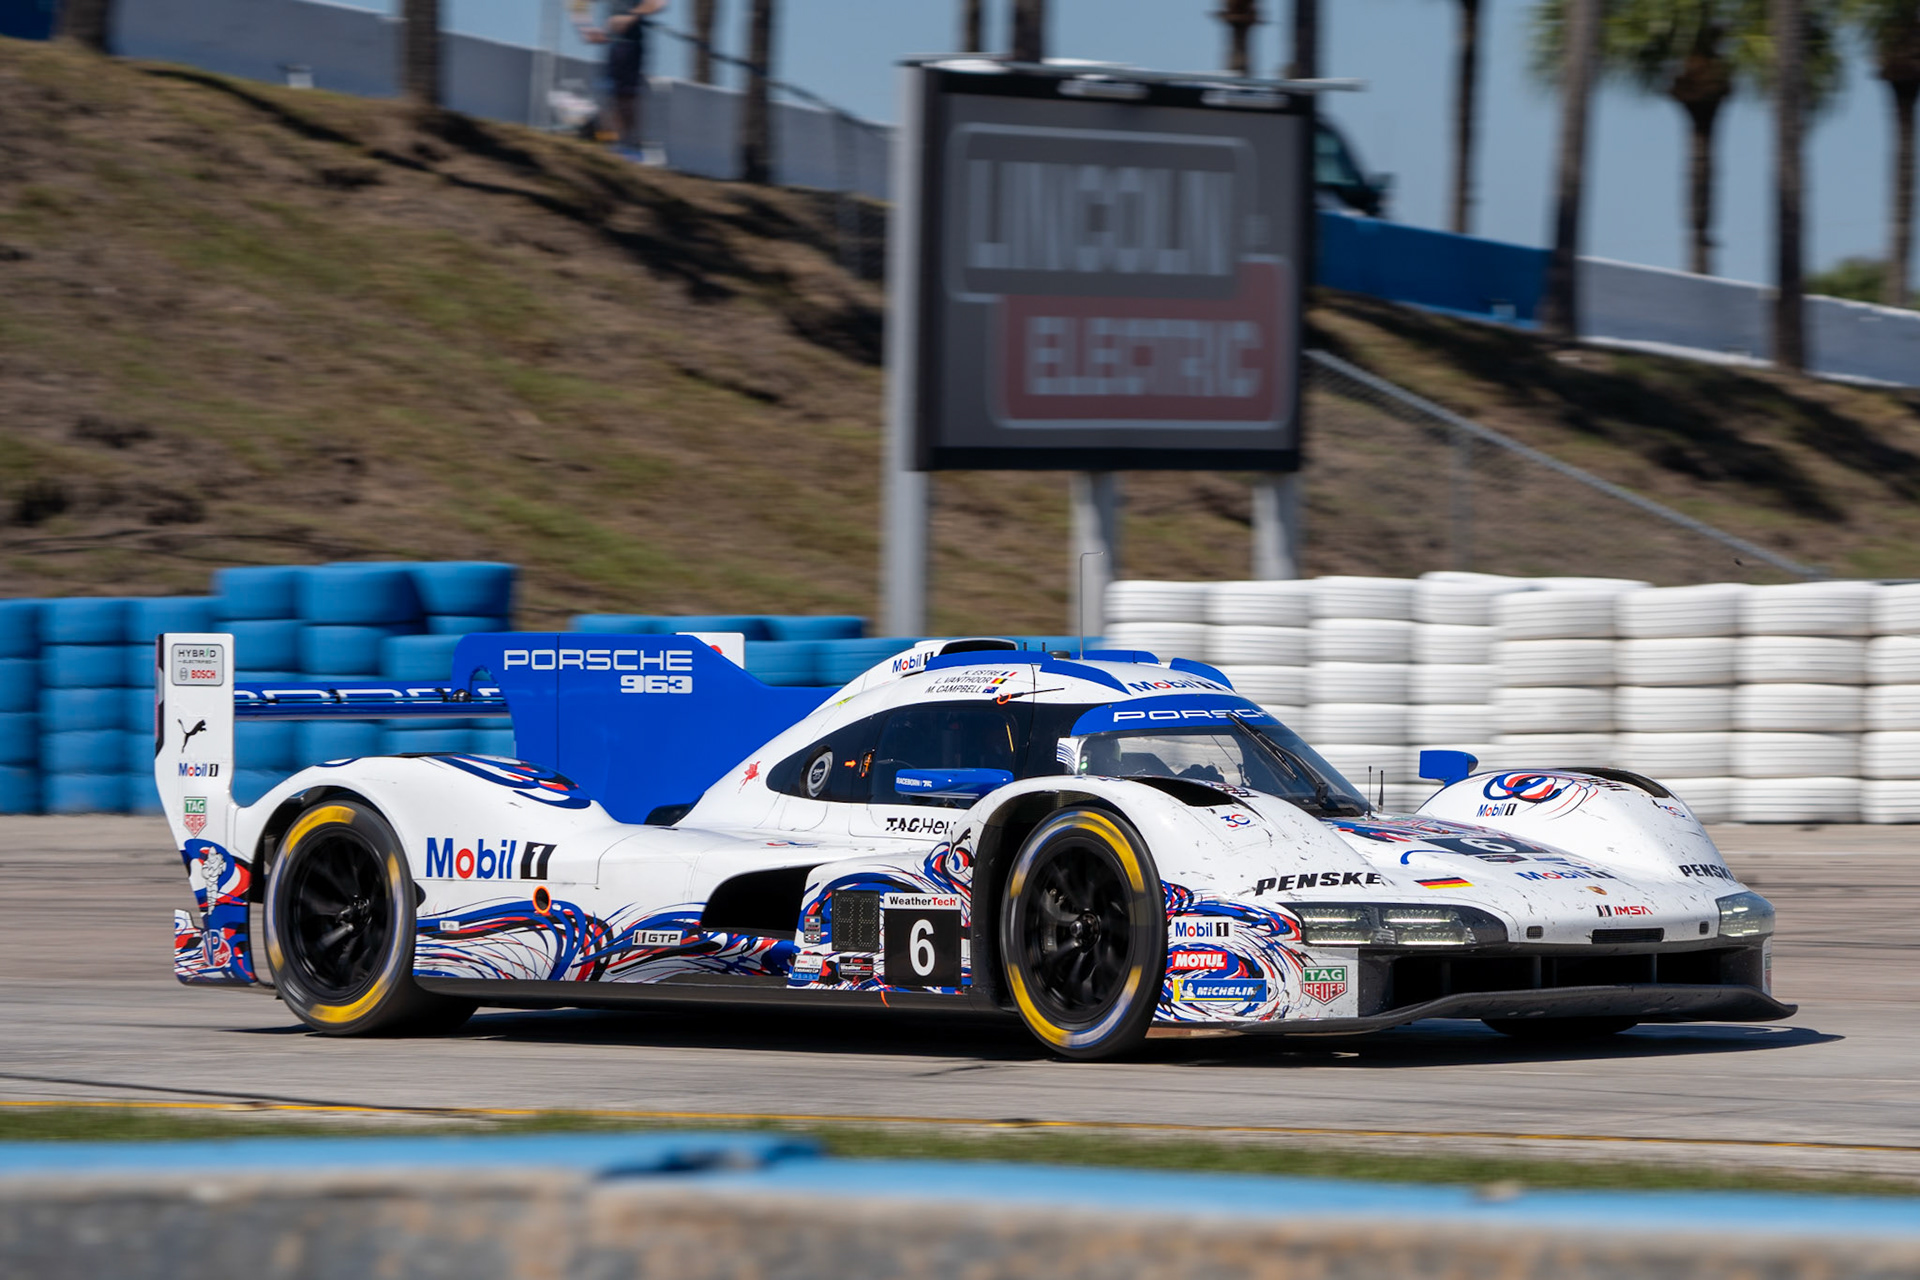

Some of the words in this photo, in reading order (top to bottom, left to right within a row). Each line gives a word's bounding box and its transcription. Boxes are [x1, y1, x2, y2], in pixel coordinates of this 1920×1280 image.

[968, 159, 1234, 275] LINCOLN
[1023, 316, 1263, 397] ELECTRIC
[178, 648, 216, 657] HYBRID
[504, 650, 693, 671] PORSCHE
[892, 653, 922, 673] Mobil
[191, 669, 216, 679] BOSCH
[620, 675, 693, 694] 963
[936, 684, 982, 693] CAMPBELL
[1127, 679, 1198, 692] Mobil
[1113, 708, 1268, 723] PORSCH
[178, 763, 208, 777] Mobil
[208, 763, 219, 777] 1
[186, 800, 205, 812] TAG
[1476, 803, 1507, 817] Mobil
[1504, 803, 1518, 816] 1
[1460, 838, 1517, 853] 6
[425, 837, 517, 879] Mobil
[520, 841, 557, 880] 1
[1514, 869, 1592, 881] Mobil
[1678, 864, 1737, 882] PENSK
[1255, 872, 1382, 896] PENSKE
[889, 896, 957, 906] WeatherTech
[1613, 905, 1653, 915] IMSA
[1175, 922, 1213, 937] Mobil
[1216, 922, 1229, 937] 1
[648, 933, 678, 943] GTP
[909, 919, 936, 977] 6
[1175, 954, 1225, 968] MOTUL
[1306, 969, 1343, 981] TAG
[1305, 983, 1344, 1001] HEUER
